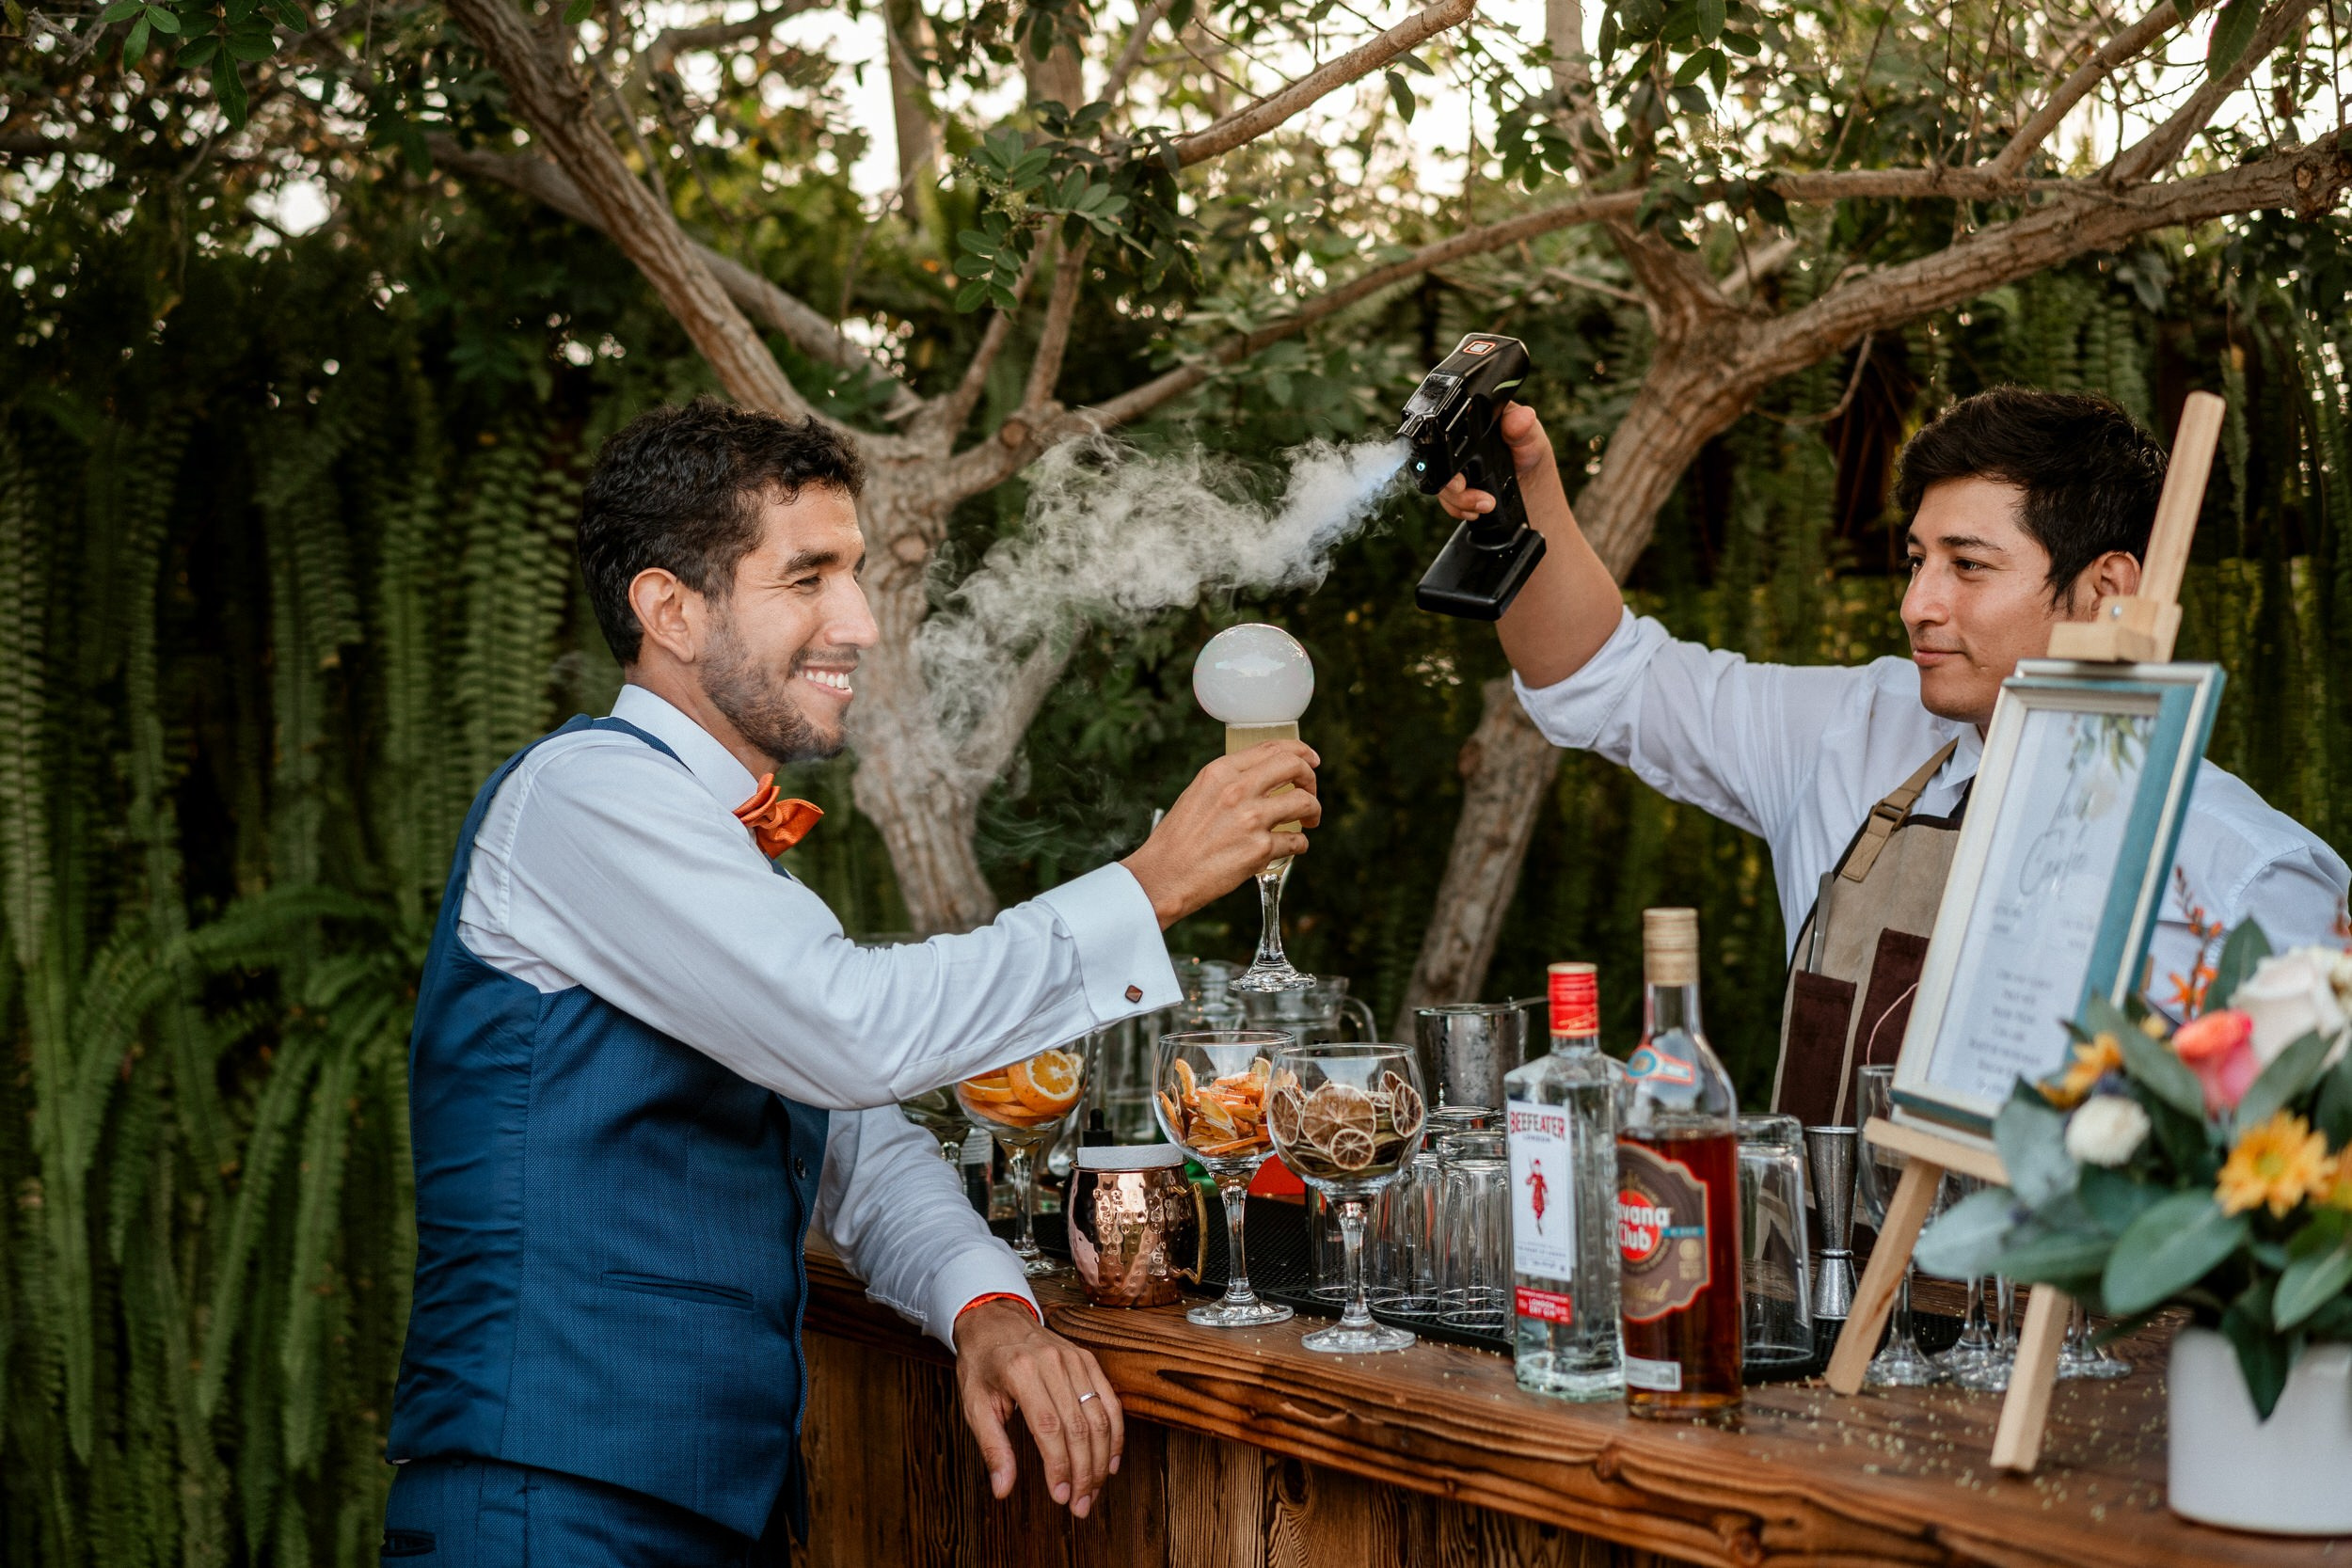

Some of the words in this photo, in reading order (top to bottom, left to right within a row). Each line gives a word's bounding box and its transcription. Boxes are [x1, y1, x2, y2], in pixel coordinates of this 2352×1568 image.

[1510, 1112, 1565, 1141] BEEFEATER
[1618, 1204, 1671, 1227] vana
[1618, 1223, 1652, 1252] Club
[1529, 1298, 1555, 1309] LONDON
